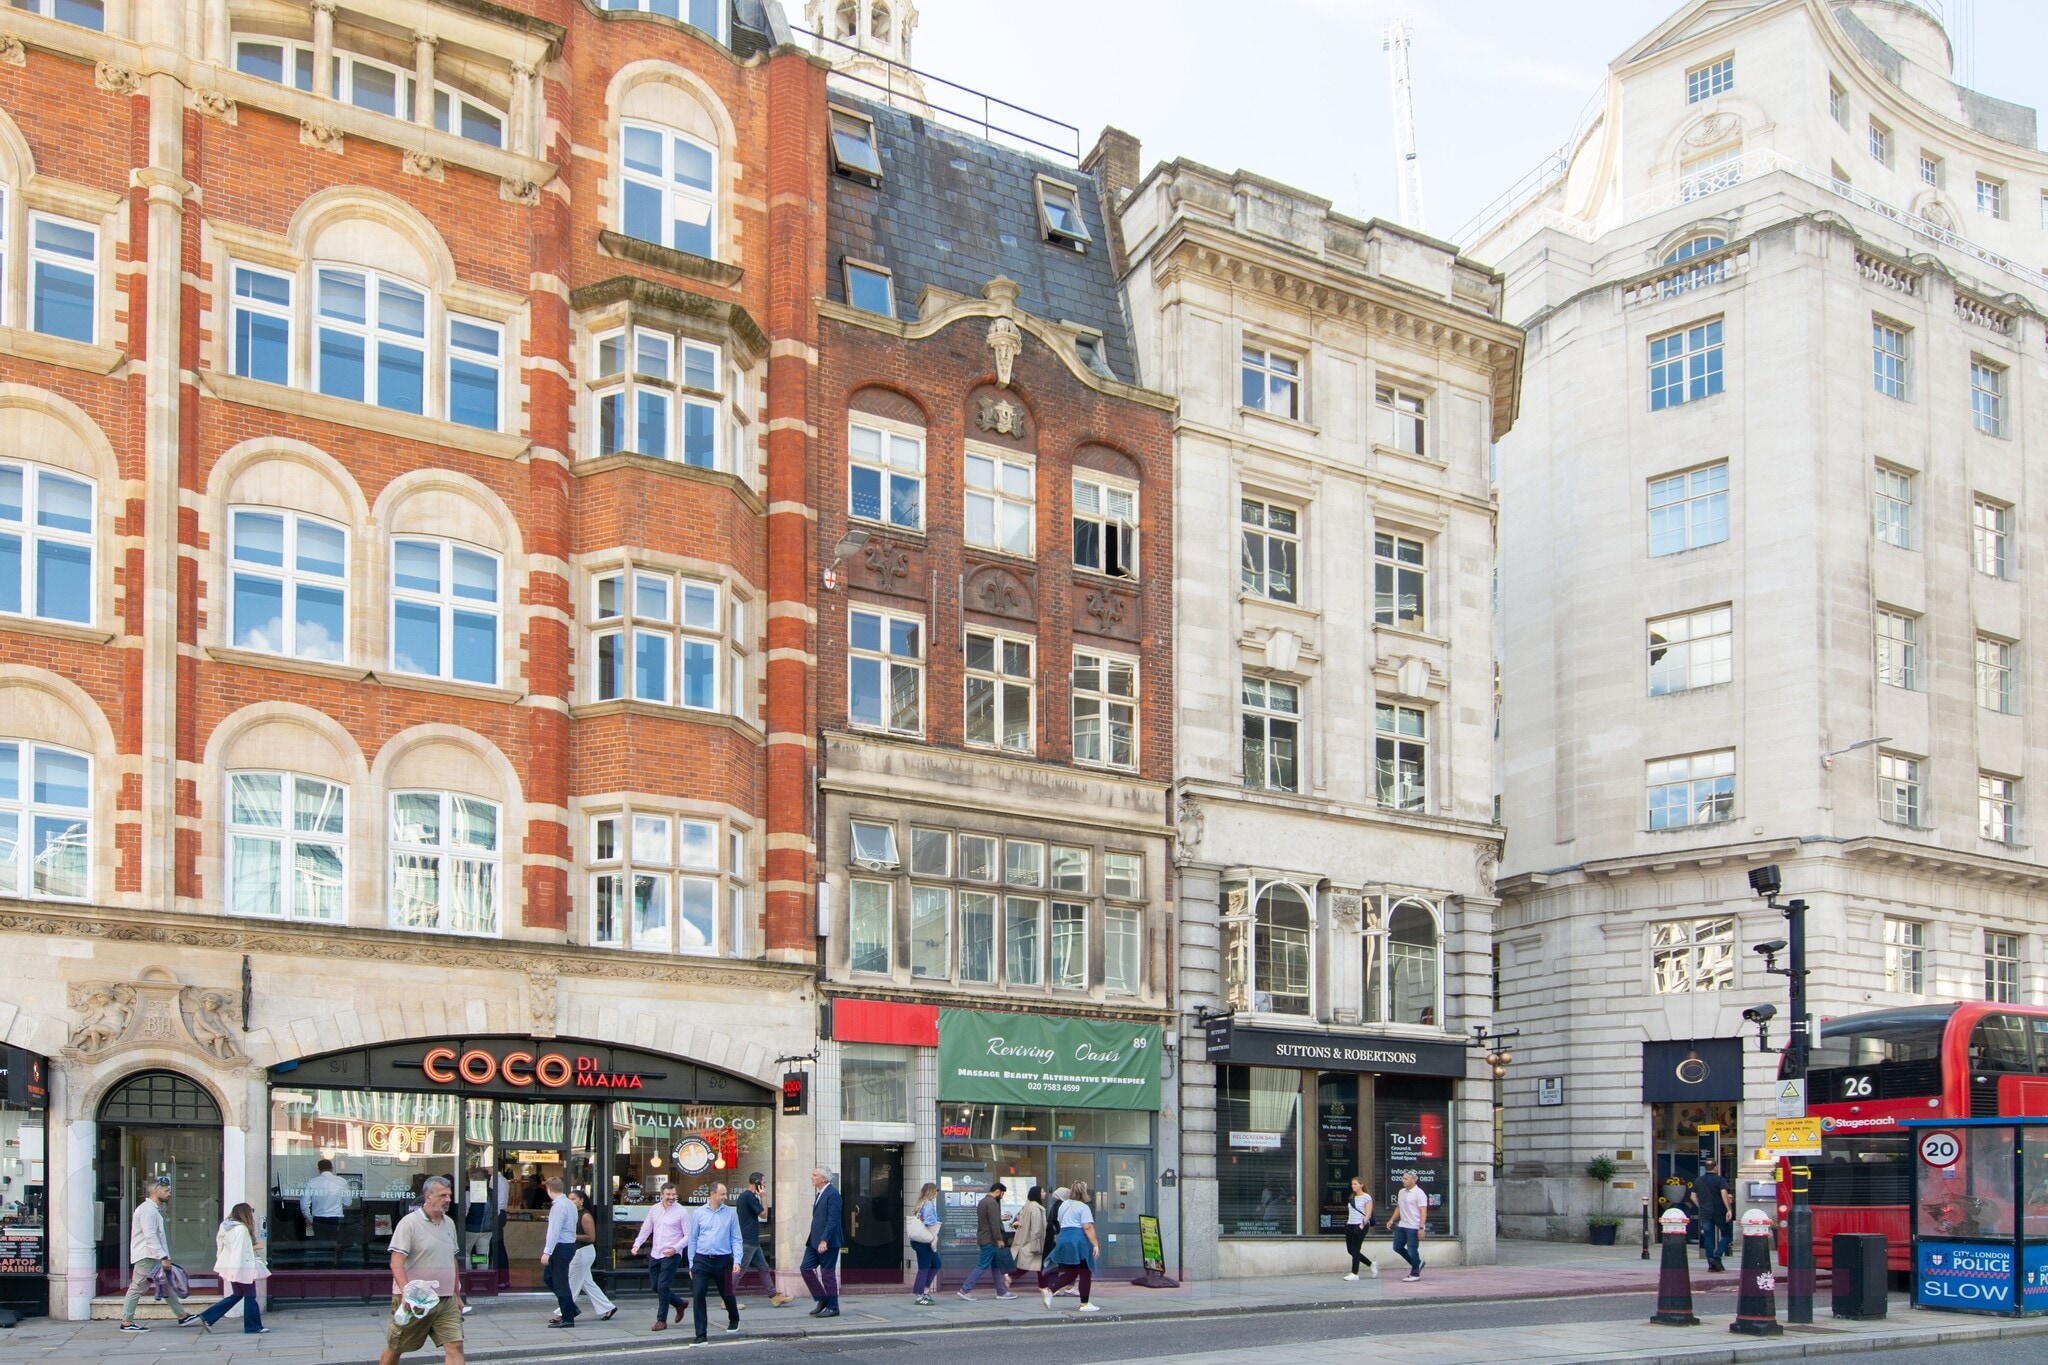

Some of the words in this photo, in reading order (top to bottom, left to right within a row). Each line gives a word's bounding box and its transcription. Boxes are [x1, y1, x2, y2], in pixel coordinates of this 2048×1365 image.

[1133, 1038, 1146, 1048] 89
[986, 1037, 1055, 1064] Reviving
[1075, 1043, 1120, 1062] Oasis
[1276, 1044, 1330, 1058] SUTTONS
[1333, 1048, 1342, 1059] &
[1344, 1049, 1416, 1064] ROBERTSONS
[329, 1060, 348, 1073] 91
[423, 1048, 572, 1088] COCO
[577, 1056, 598, 1072] DI
[576, 1074, 643, 1088] MAMA
[1044, 1083, 1061, 1091] 7583
[1062, 1084, 1080, 1092] 4599
[1845, 1076, 1872, 1096] 26
[380, 1103, 403, 1116] TO
[413, 1106, 440, 1118] GO
[632, 1114, 697, 1128] ITALIAN
[704, 1117, 725, 1129] TO
[732, 1118, 756, 1130] GO
[1836, 1116, 1895, 1128] Stagecoach
[942, 1126, 970, 1136] OPEN
[1391, 1134, 1406, 1144] To
[1408, 1134, 1427, 1145] Let
[1927, 1142, 1954, 1156] 20
[1953, 1258, 2010, 1272] POLICE
[1925, 1281, 2008, 1300] SLOW
